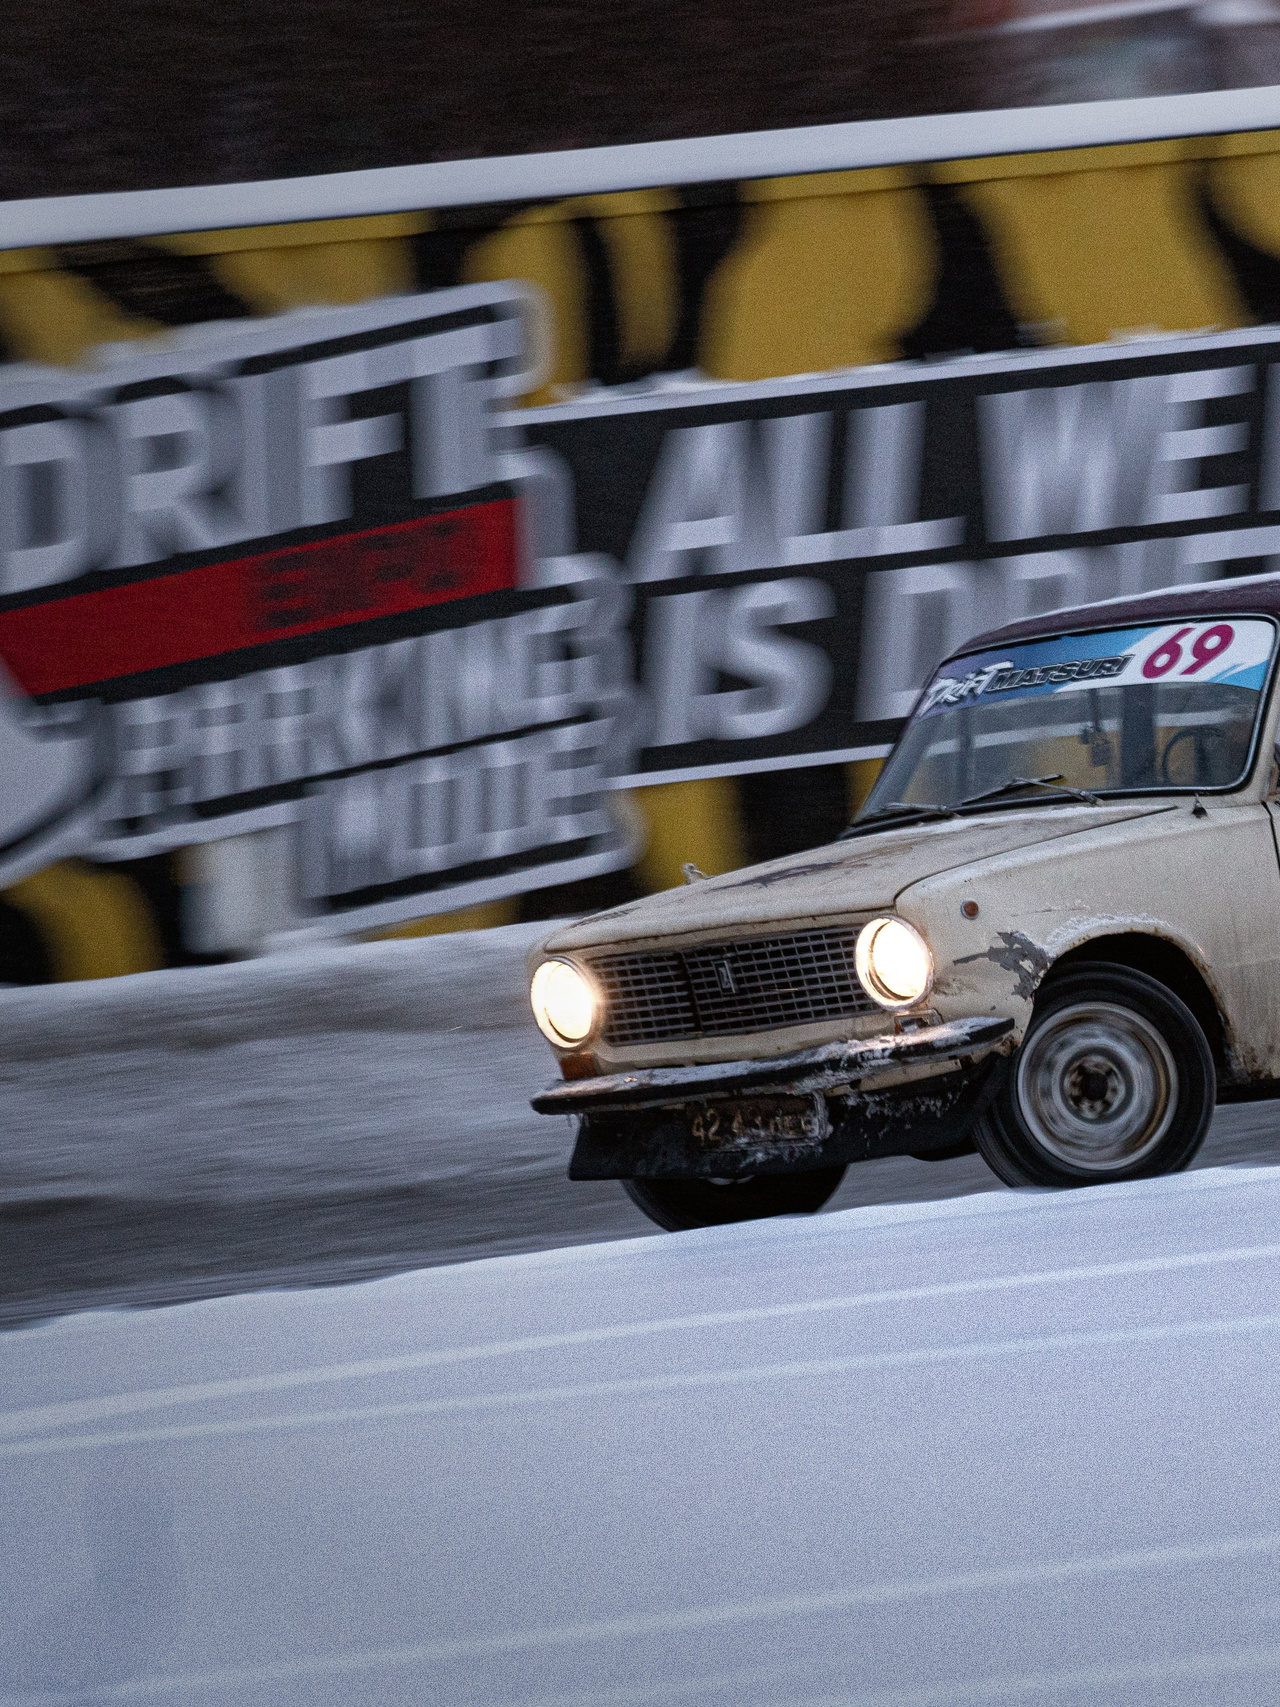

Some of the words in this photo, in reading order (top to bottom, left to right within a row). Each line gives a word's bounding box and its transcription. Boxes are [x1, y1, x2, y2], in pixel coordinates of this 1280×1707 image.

[0, 320, 522, 594] DRIFT
[626, 402, 964, 584] ALL
[978, 365, 1254, 542] WE
[116, 602, 600, 824] PARKING
[640, 577, 834, 748] IS
[984, 654, 1136, 692] MATSURI
[1142, 624, 1233, 679] 69
[302, 718, 610, 897] MODE
